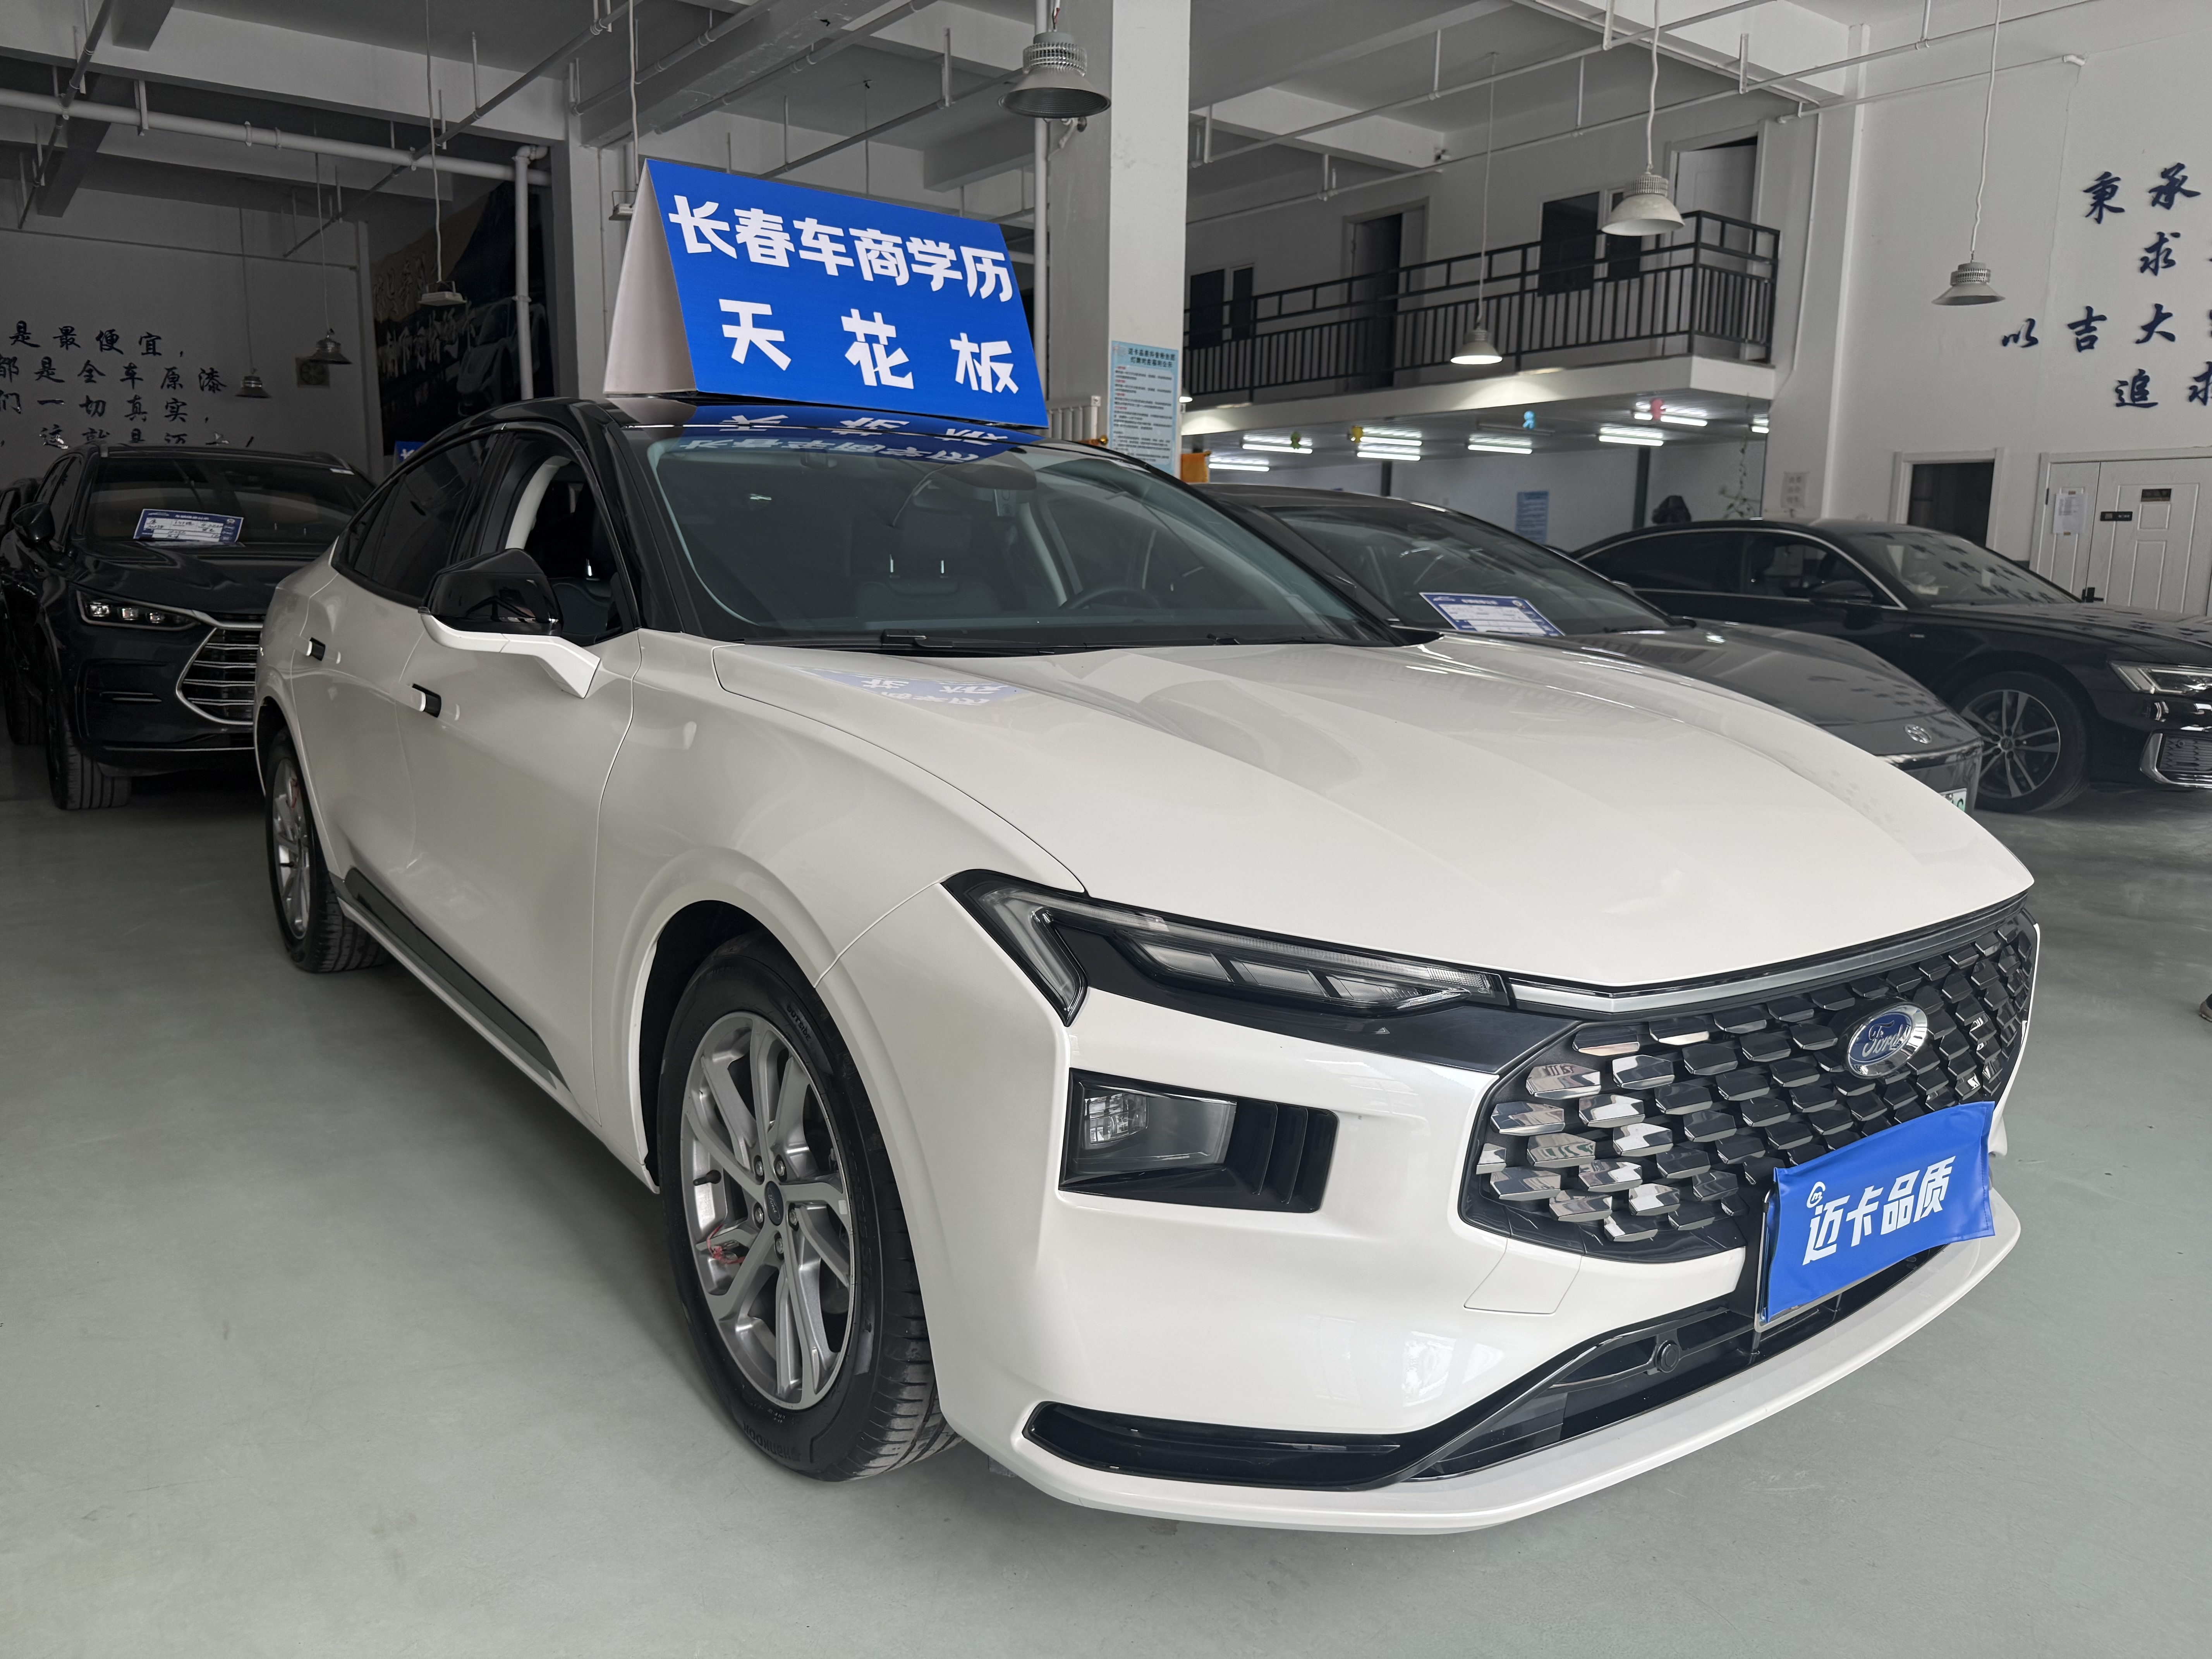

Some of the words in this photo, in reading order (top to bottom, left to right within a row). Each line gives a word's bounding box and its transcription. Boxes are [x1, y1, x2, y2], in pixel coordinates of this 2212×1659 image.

[2083, 163, 2202, 224] 秉承
[668, 195, 1013, 302] 长春车商学历
[718, 299, 1018, 394] 天花板
[2001, 304, 2212, 352] 以吉大
[787, 1002, 812, 1041] OUTSIDE
[1862, 1020, 1904, 1057] Ford
[1803, 1156, 1956, 1265] 迈卡品质
